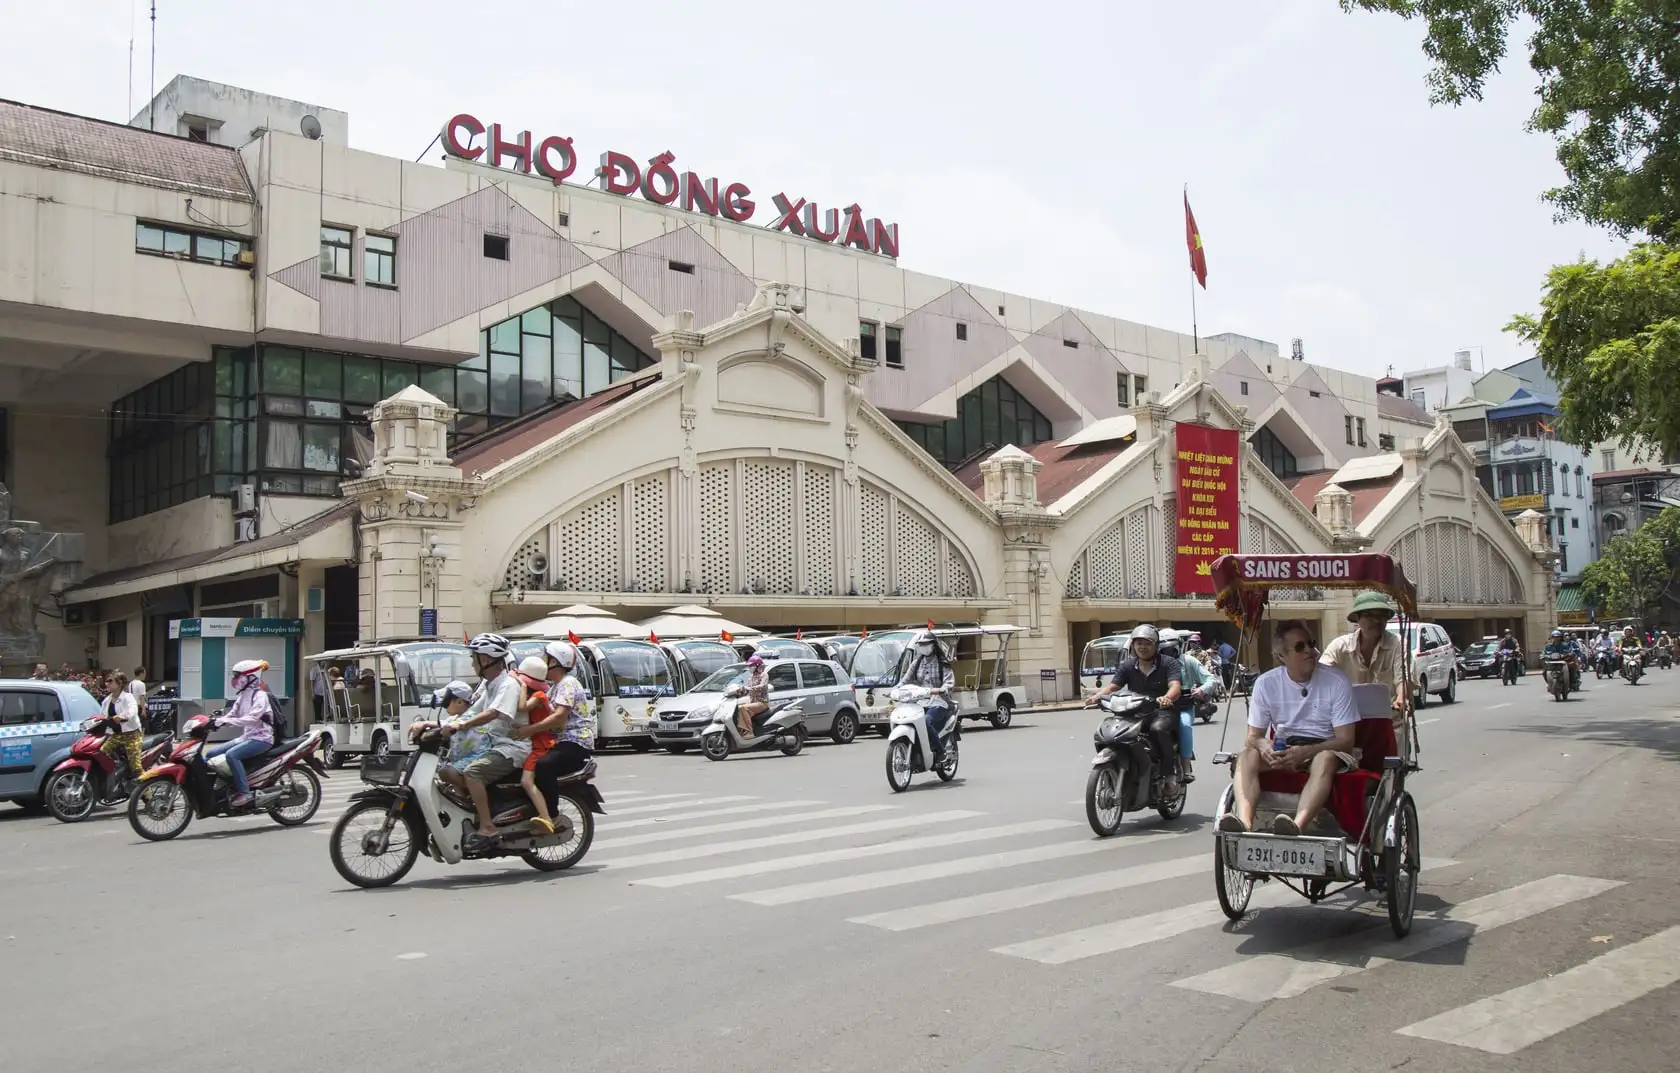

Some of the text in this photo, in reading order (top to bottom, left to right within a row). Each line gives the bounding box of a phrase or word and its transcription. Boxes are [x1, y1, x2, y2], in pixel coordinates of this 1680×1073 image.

[441, 113, 899, 257] CHỢ ĐỒNG XUÂN
[1201, 547, 1215, 556] 2016
[1244, 559, 1350, 578] SANS SOUCI
[243, 625, 260, 633] Điểm
